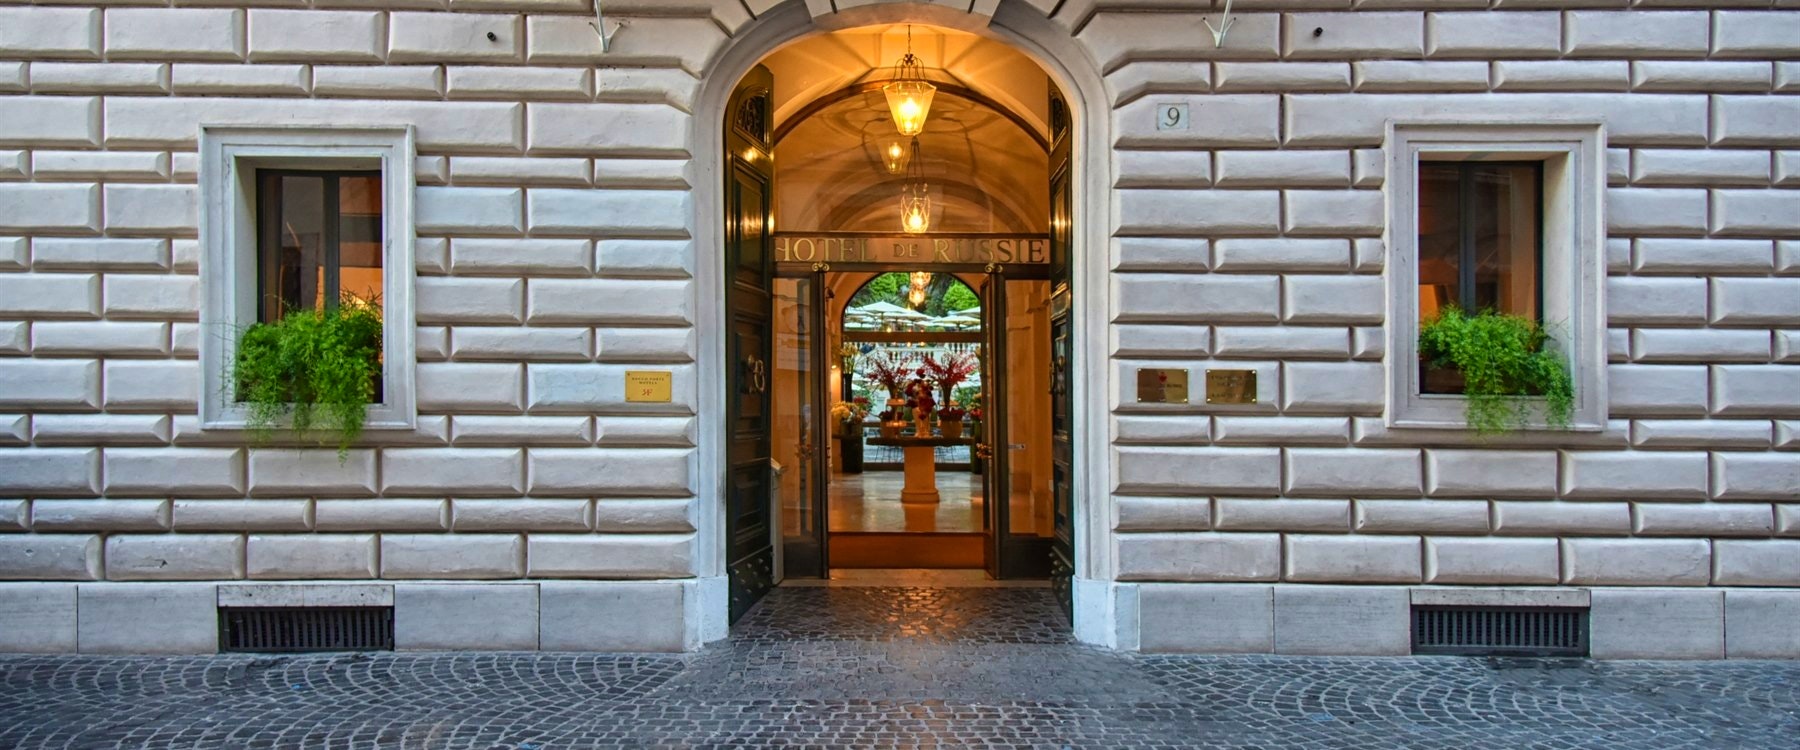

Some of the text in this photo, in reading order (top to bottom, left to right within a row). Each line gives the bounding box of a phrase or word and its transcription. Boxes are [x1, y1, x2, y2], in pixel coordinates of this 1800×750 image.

[1164, 106, 1180, 127] 9
[775, 237, 1046, 263] HOTEL DE RUSSIE
